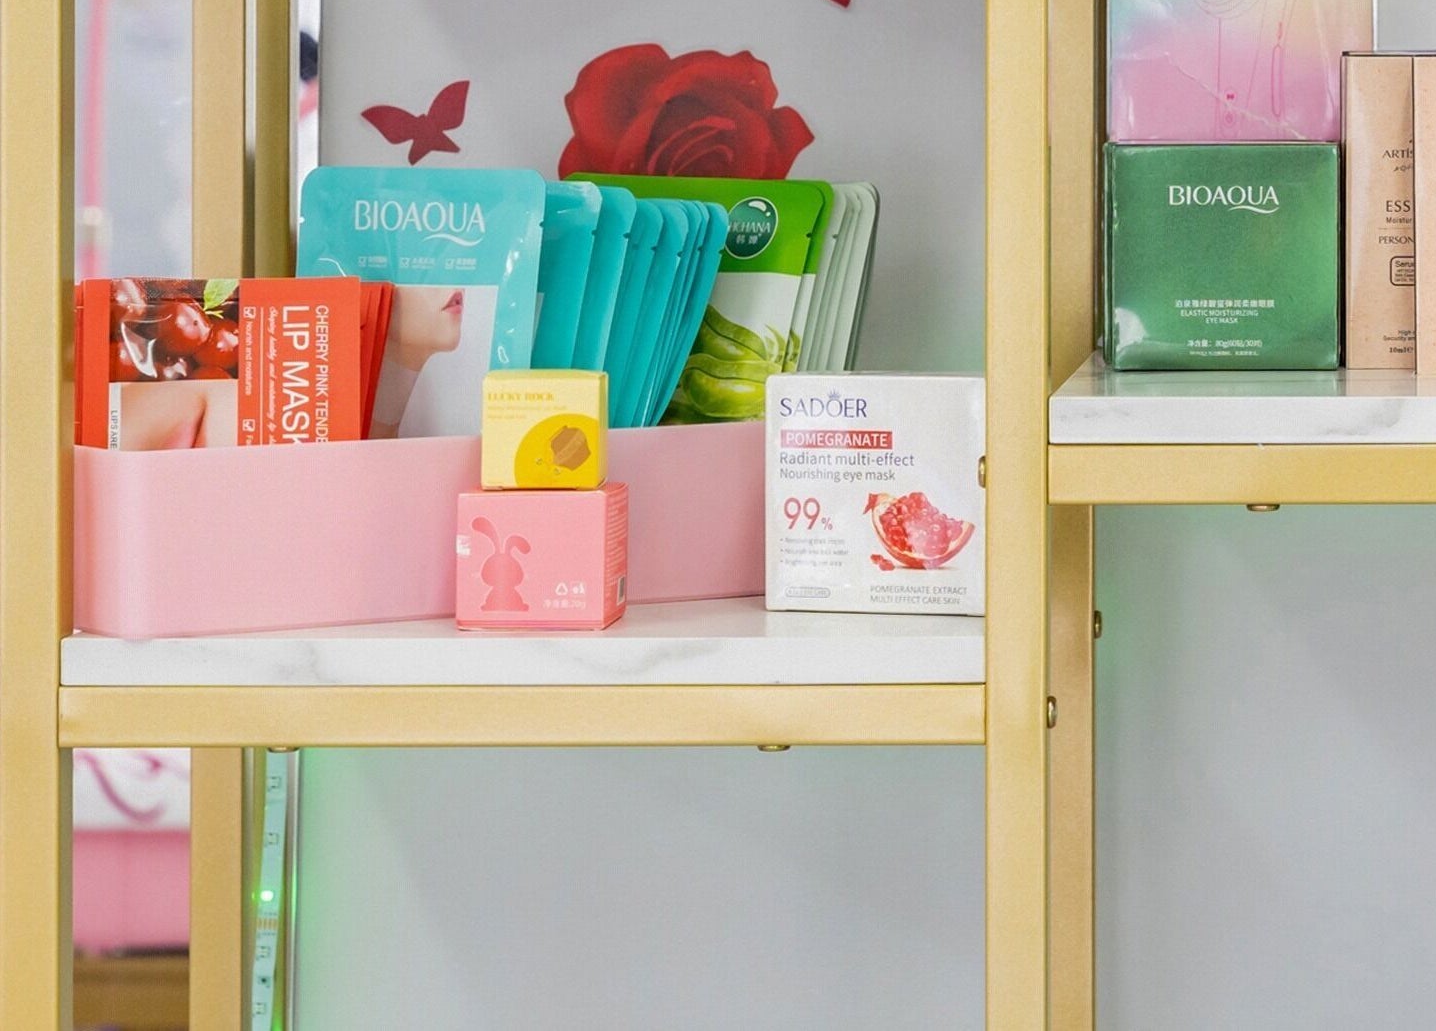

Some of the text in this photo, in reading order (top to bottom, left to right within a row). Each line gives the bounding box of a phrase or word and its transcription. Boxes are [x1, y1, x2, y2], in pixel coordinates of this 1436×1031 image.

[1168, 185, 1279, 214] BIOAQUA
[355, 200, 486, 246] BIOAQUA
[245, 321, 253, 345] Nourish
[282, 306, 309, 350] LIP
[315, 304, 329, 362] CHERRY
[245, 347, 253, 360] and
[315, 366, 329, 397] PINK
[780, 397, 867, 418] SADOER
[786, 432, 888, 447] POMEGRANATE
[780, 452, 915, 467] Radiant multi-effect
[780, 469, 896, 483] Nourishing eye mask
[784, 497, 833, 531] 99%
[870, 585, 967, 596] POMEGRANATE EXTRACT
[870, 595, 960, 605] MULTI EFFECT CARE SKIN
